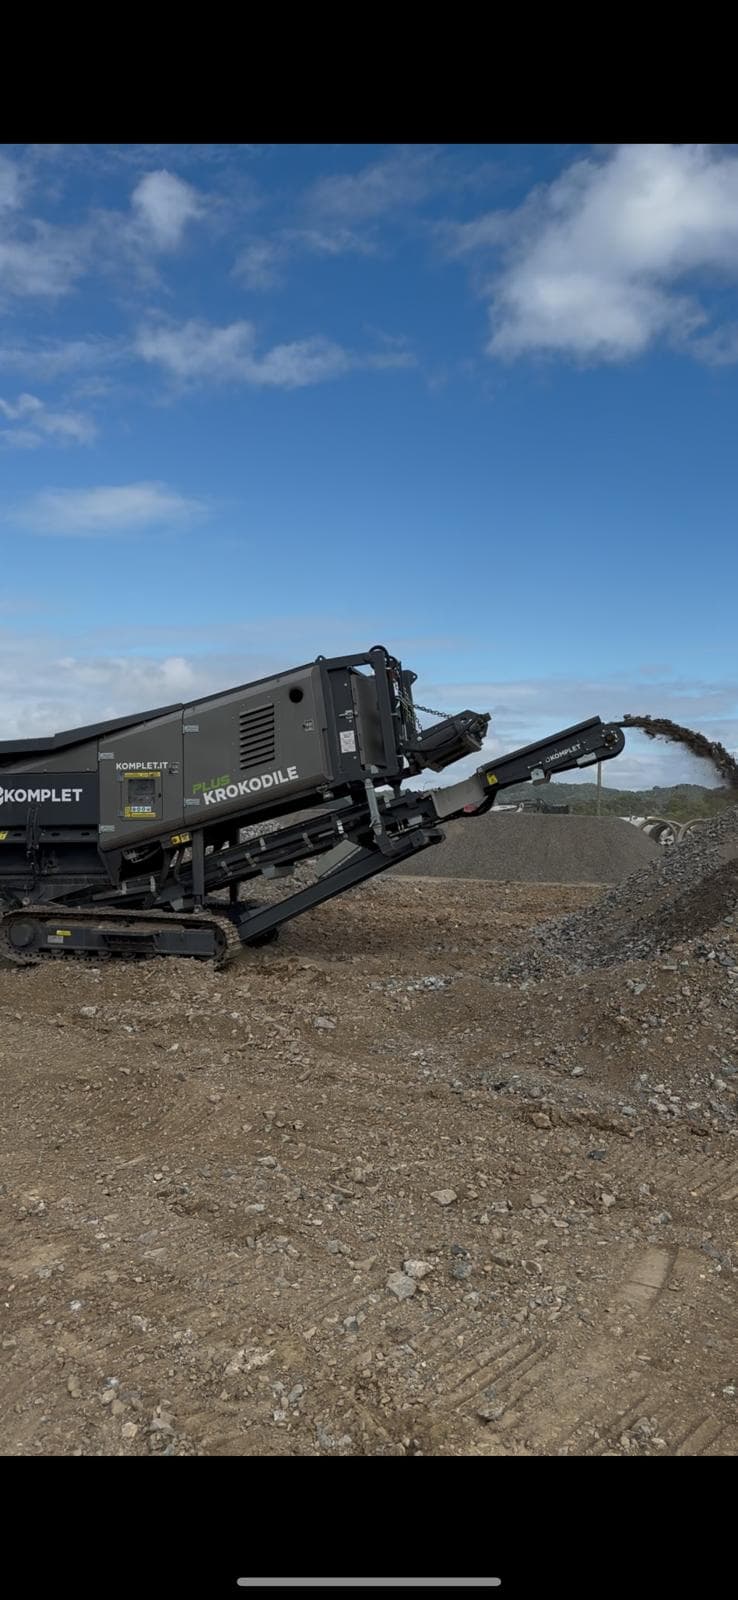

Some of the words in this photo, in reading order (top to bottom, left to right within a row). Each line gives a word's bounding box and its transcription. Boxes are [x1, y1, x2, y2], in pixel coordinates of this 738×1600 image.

[550, 743, 580, 760] KOMPLET
[115, 761, 168, 770] KOMPLET.IT
[192, 775, 230, 794] PLUS
[203, 766, 299, 805] KROKODILE
[4, 788, 83, 802] KOMPLET
